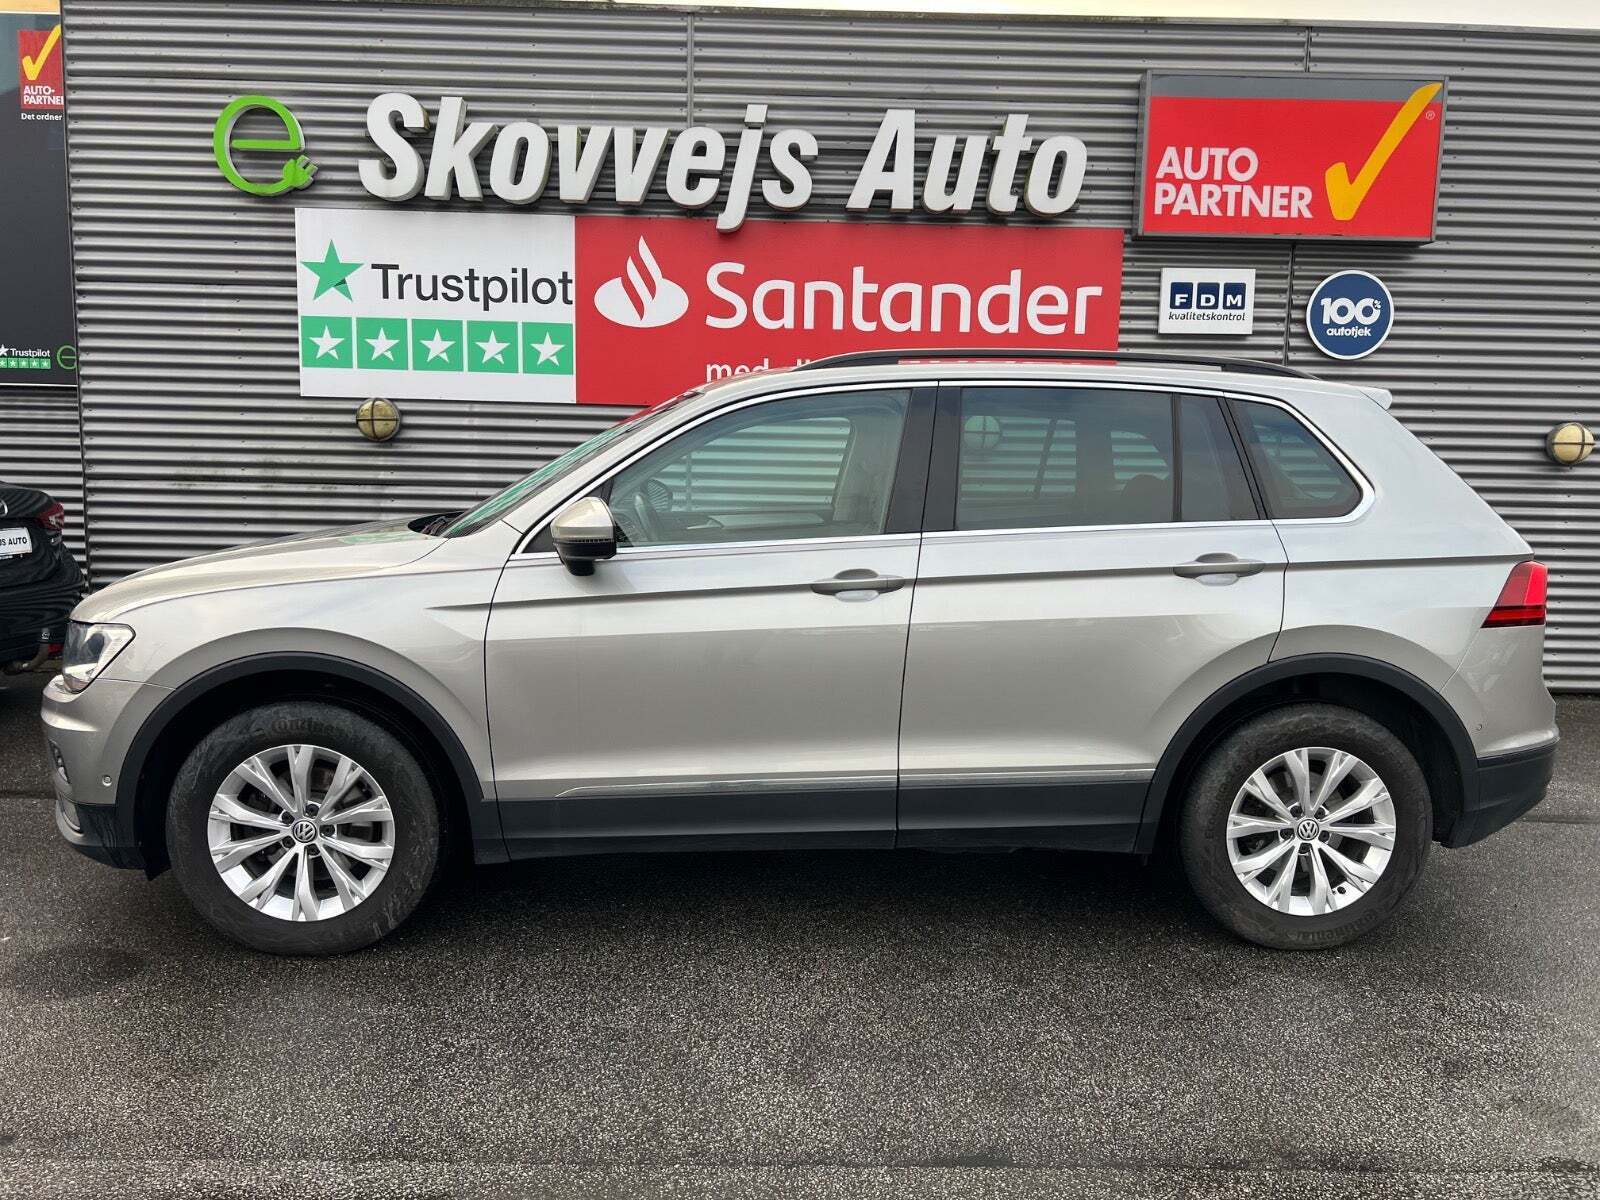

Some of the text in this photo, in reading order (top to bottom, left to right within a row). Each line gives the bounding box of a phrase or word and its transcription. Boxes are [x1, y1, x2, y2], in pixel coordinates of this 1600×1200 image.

[23, 85, 55, 95] AUTO-
[20, 112, 62, 121] Det ordner
[358, 92, 1087, 234] Skovvejs Auto
[1155, 146, 1259, 182] AUTO
[1153, 183, 1314, 219] PARTNER
[371, 263, 573, 311] Trustpilot
[705, 261, 1103, 335] Santander
[1173, 291, 1243, 307] FDM
[1168, 311, 1245, 322] kvalitetskontrol
[10, 348, 50, 359] Trustpilot
[8, 536, 28, 545] AUTO
